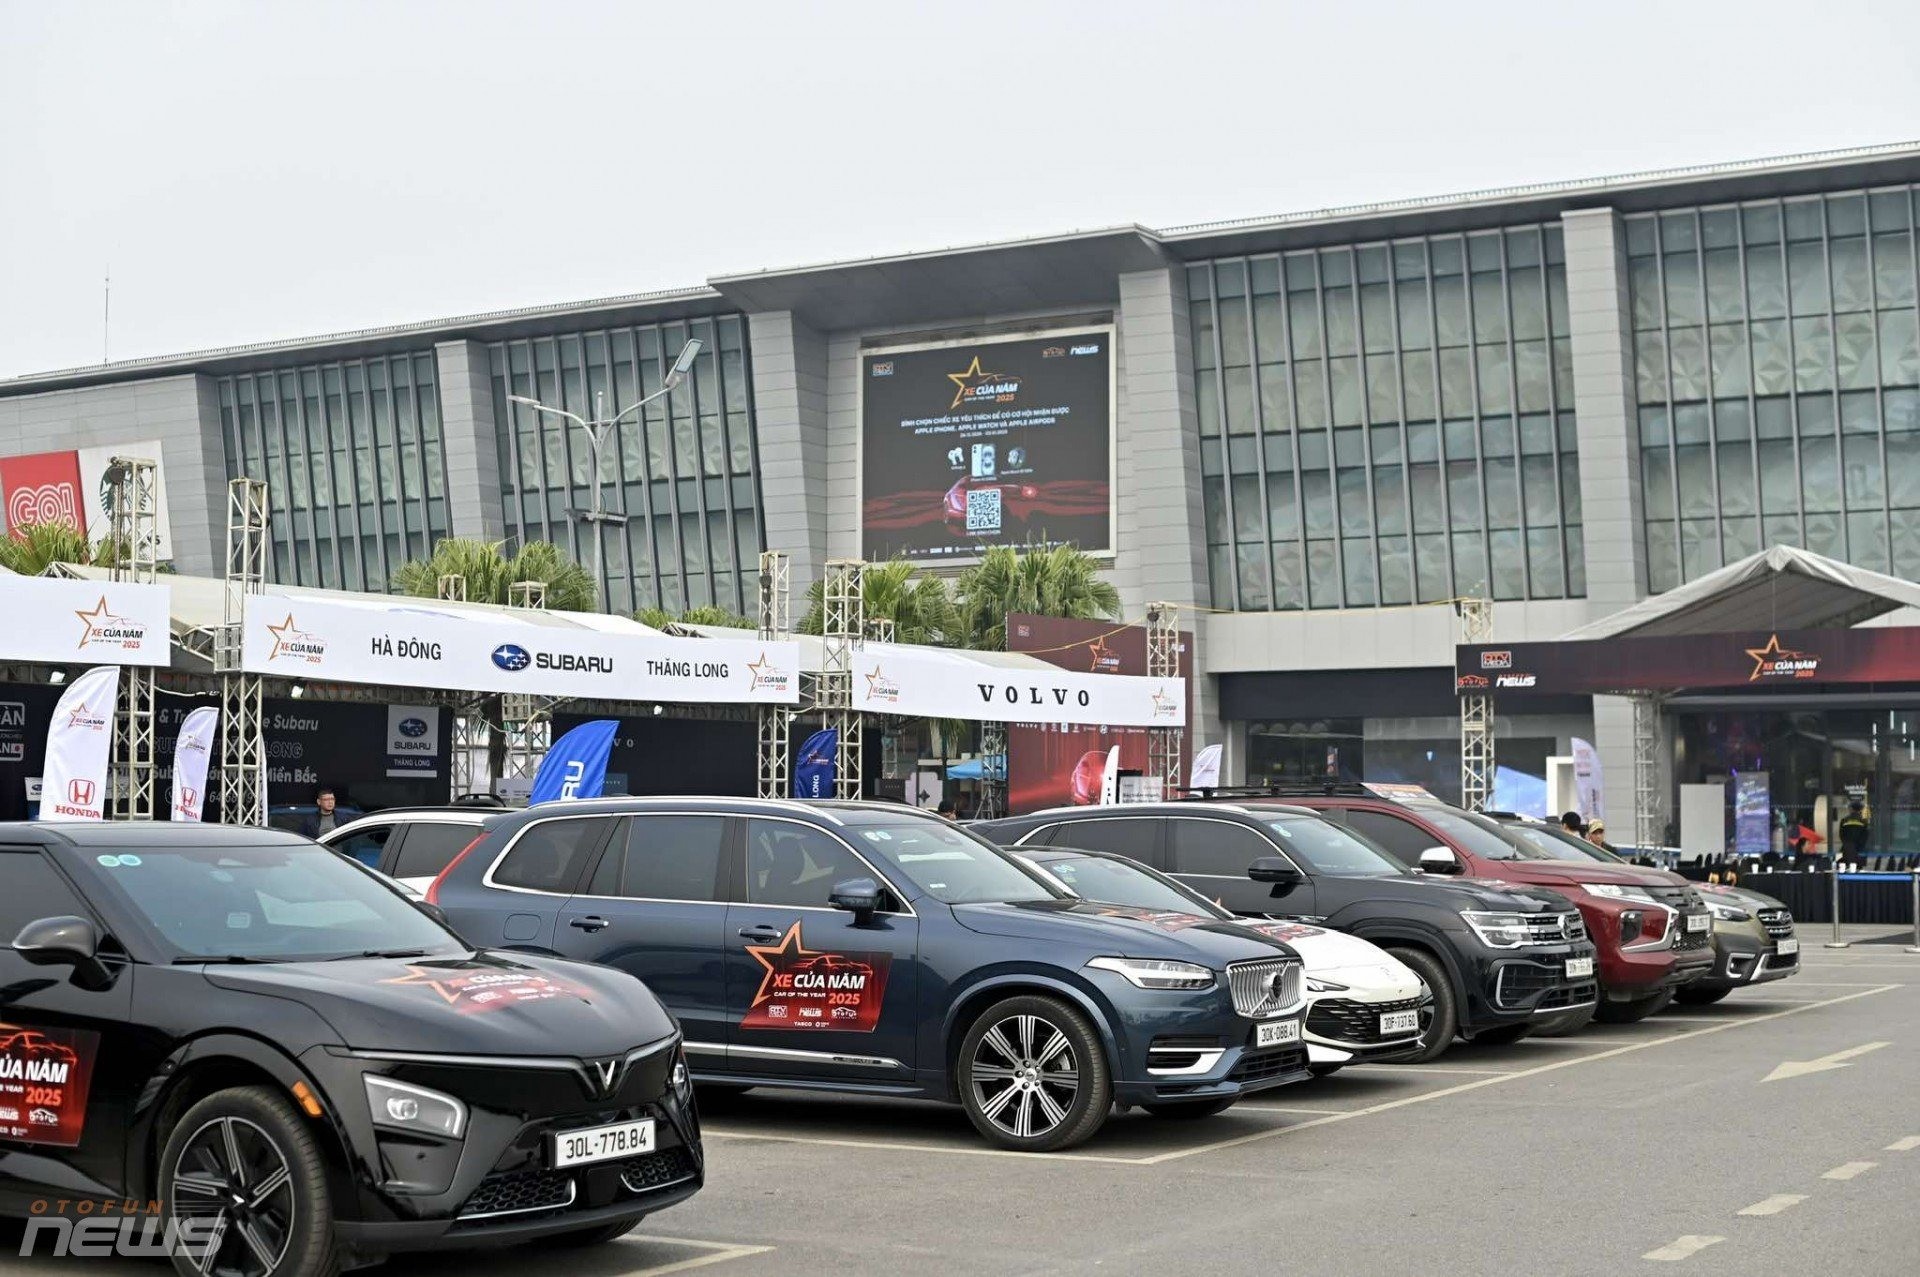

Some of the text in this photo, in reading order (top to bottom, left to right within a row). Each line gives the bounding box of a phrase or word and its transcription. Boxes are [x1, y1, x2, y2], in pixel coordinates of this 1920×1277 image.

[996, 394, 1015, 402] 2025
[91, 628, 102, 637] XE
[122, 640, 140, 649] 2025
[280, 642, 289, 650] XE
[371, 634, 442, 661] HÀ ĐÔNG
[306, 655, 321, 663] 2025
[536, 652, 729, 678] SUBARU THĂNG LONG
[977, 683, 1090, 707] VOLVO
[273, 714, 319, 731] Subaru
[393, 741, 431, 751] SUBARU
[55, 805, 100, 818] HONDA
[773, 970, 865, 990] XE CỦA NĂM
[828, 993, 860, 1005] 2025
[0, 1053, 69, 1084] ỦA NĂM
[5, 1084, 24, 1093] YEAR
[25, 1086, 62, 1107] 2025
[566, 1126, 647, 1159] 30L-778.84
